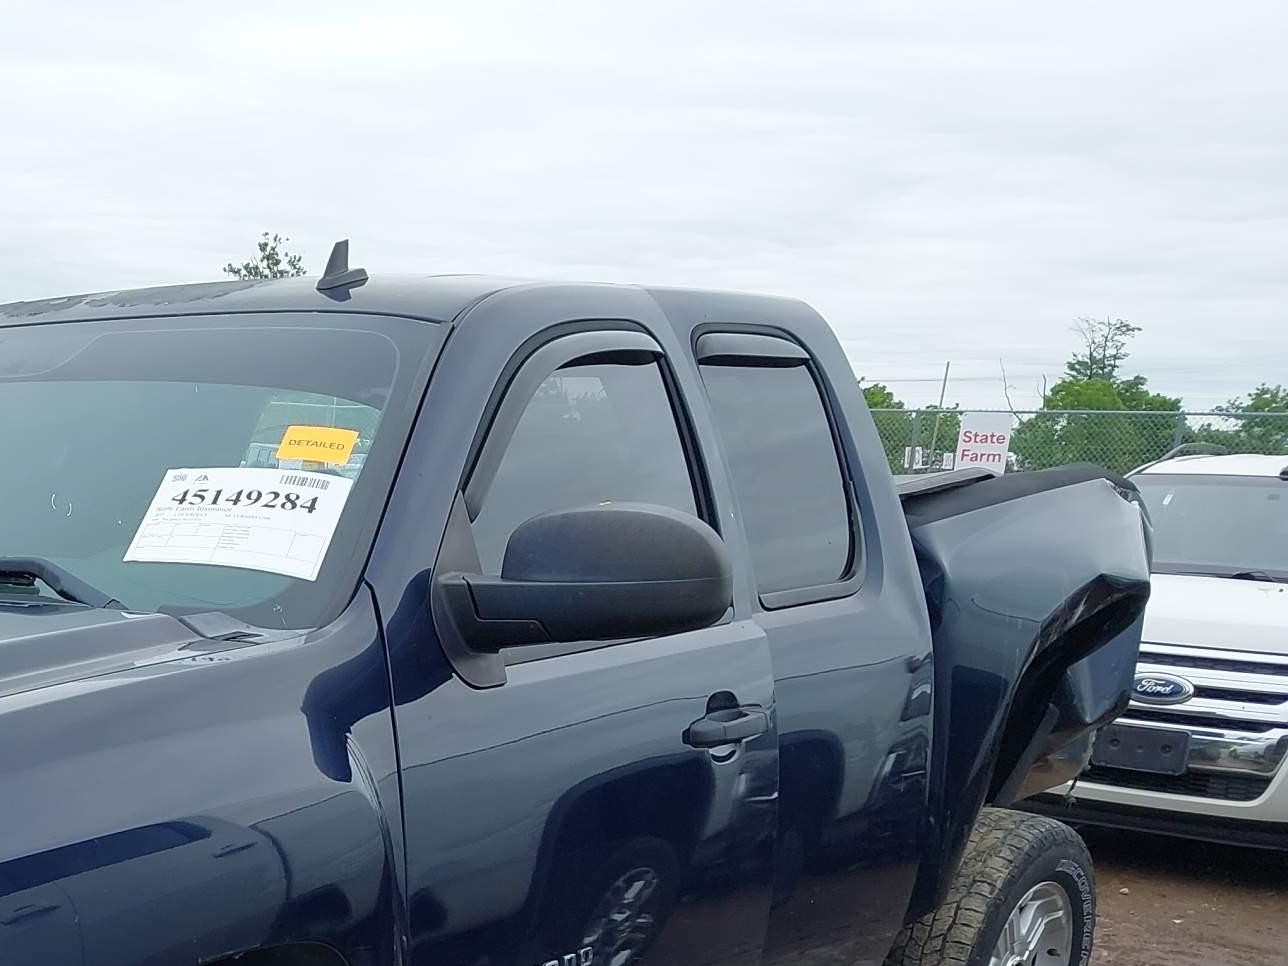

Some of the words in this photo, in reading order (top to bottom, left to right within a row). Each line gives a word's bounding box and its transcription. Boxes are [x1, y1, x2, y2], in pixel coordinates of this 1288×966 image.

[287, 438, 346, 451] DETAILED
[962, 430, 1006, 445] State
[960, 449, 1002, 463] Farm
[171, 488, 320, 514] 45149284
[1136, 678, 1175, 695] Ford
